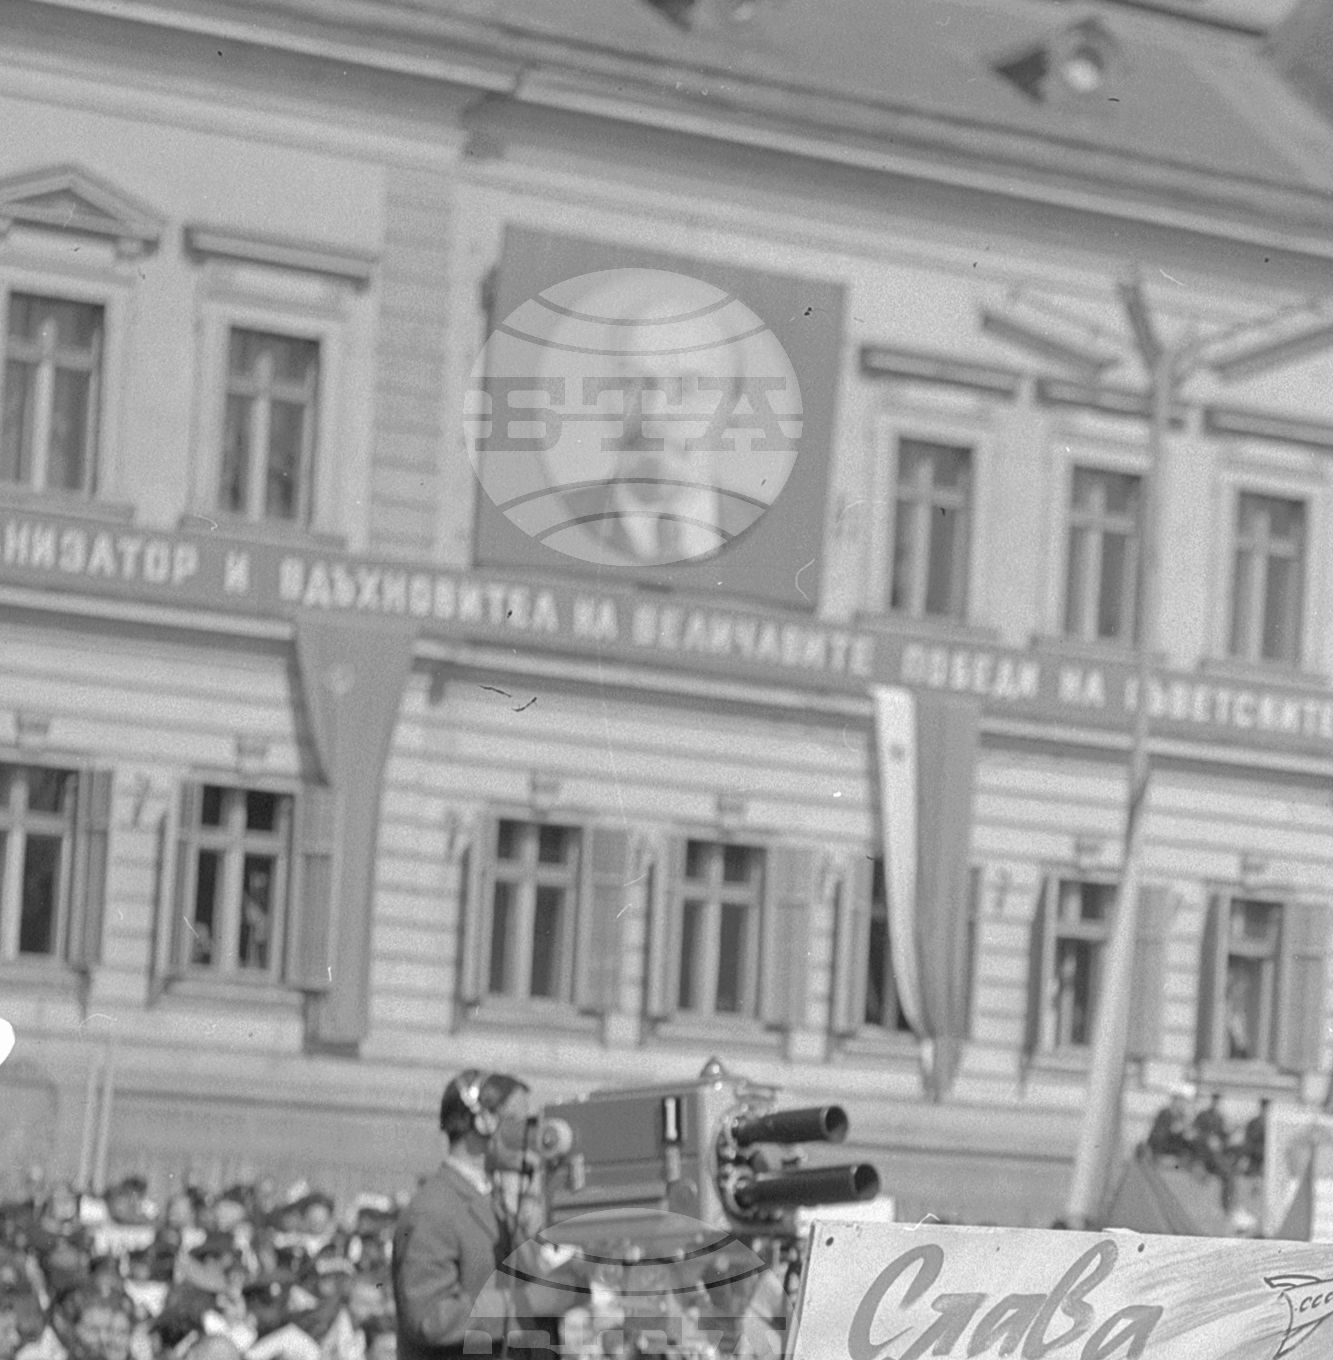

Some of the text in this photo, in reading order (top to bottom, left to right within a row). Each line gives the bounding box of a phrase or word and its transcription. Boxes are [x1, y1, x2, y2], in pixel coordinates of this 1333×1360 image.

[224, 549, 250, 594] И
[572, 597, 618, 641] НА
[1059, 665, 1105, 707] НА
